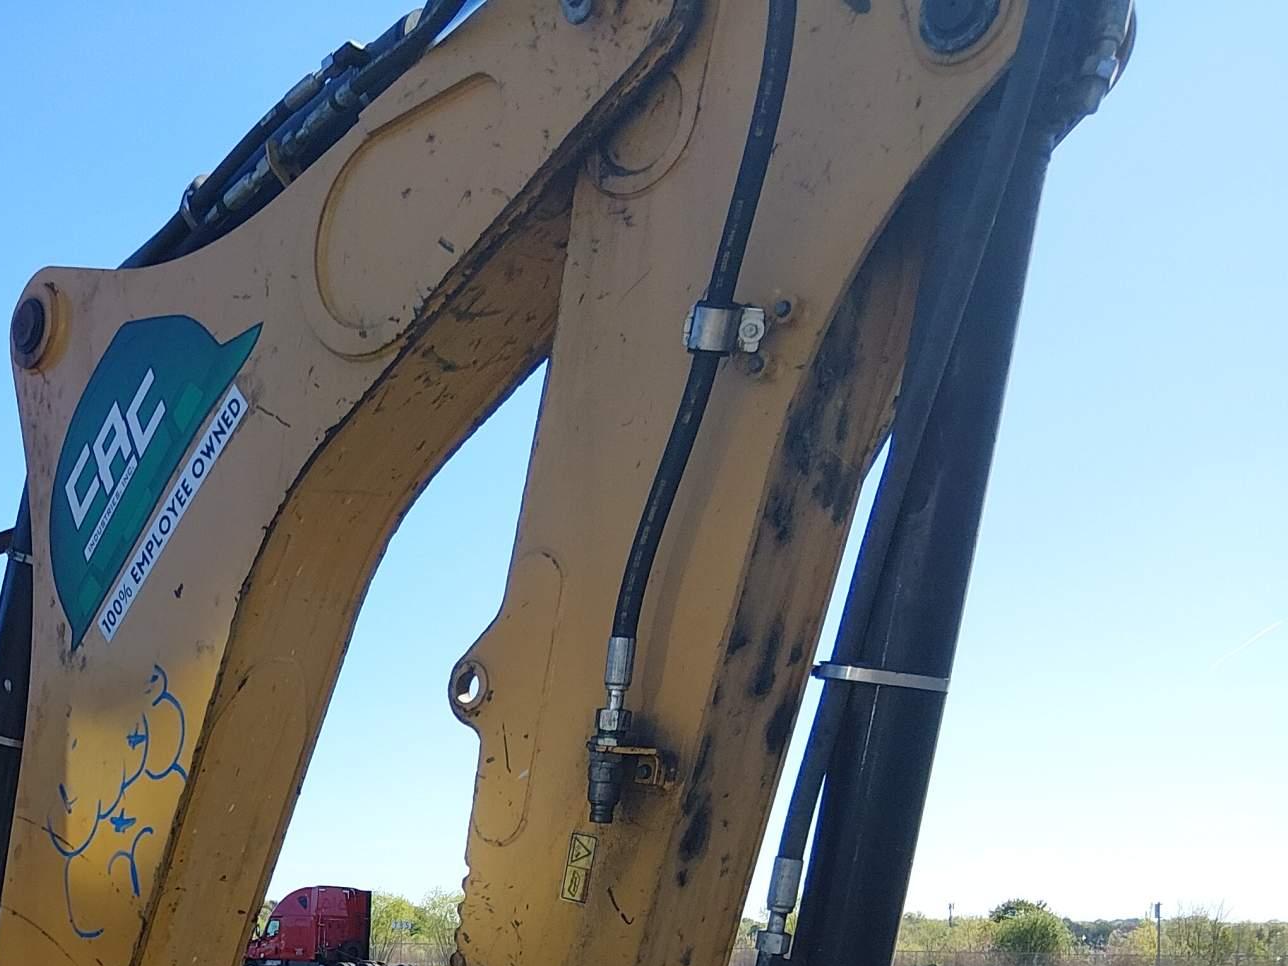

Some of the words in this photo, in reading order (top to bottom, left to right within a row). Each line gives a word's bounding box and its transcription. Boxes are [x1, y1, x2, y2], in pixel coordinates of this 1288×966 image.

[64, 367, 167, 531] CAC
[101, 584, 133, 634] 100%
[131, 482, 194, 585] EMPLOYEE
[193, 397, 241, 479] OWNED
